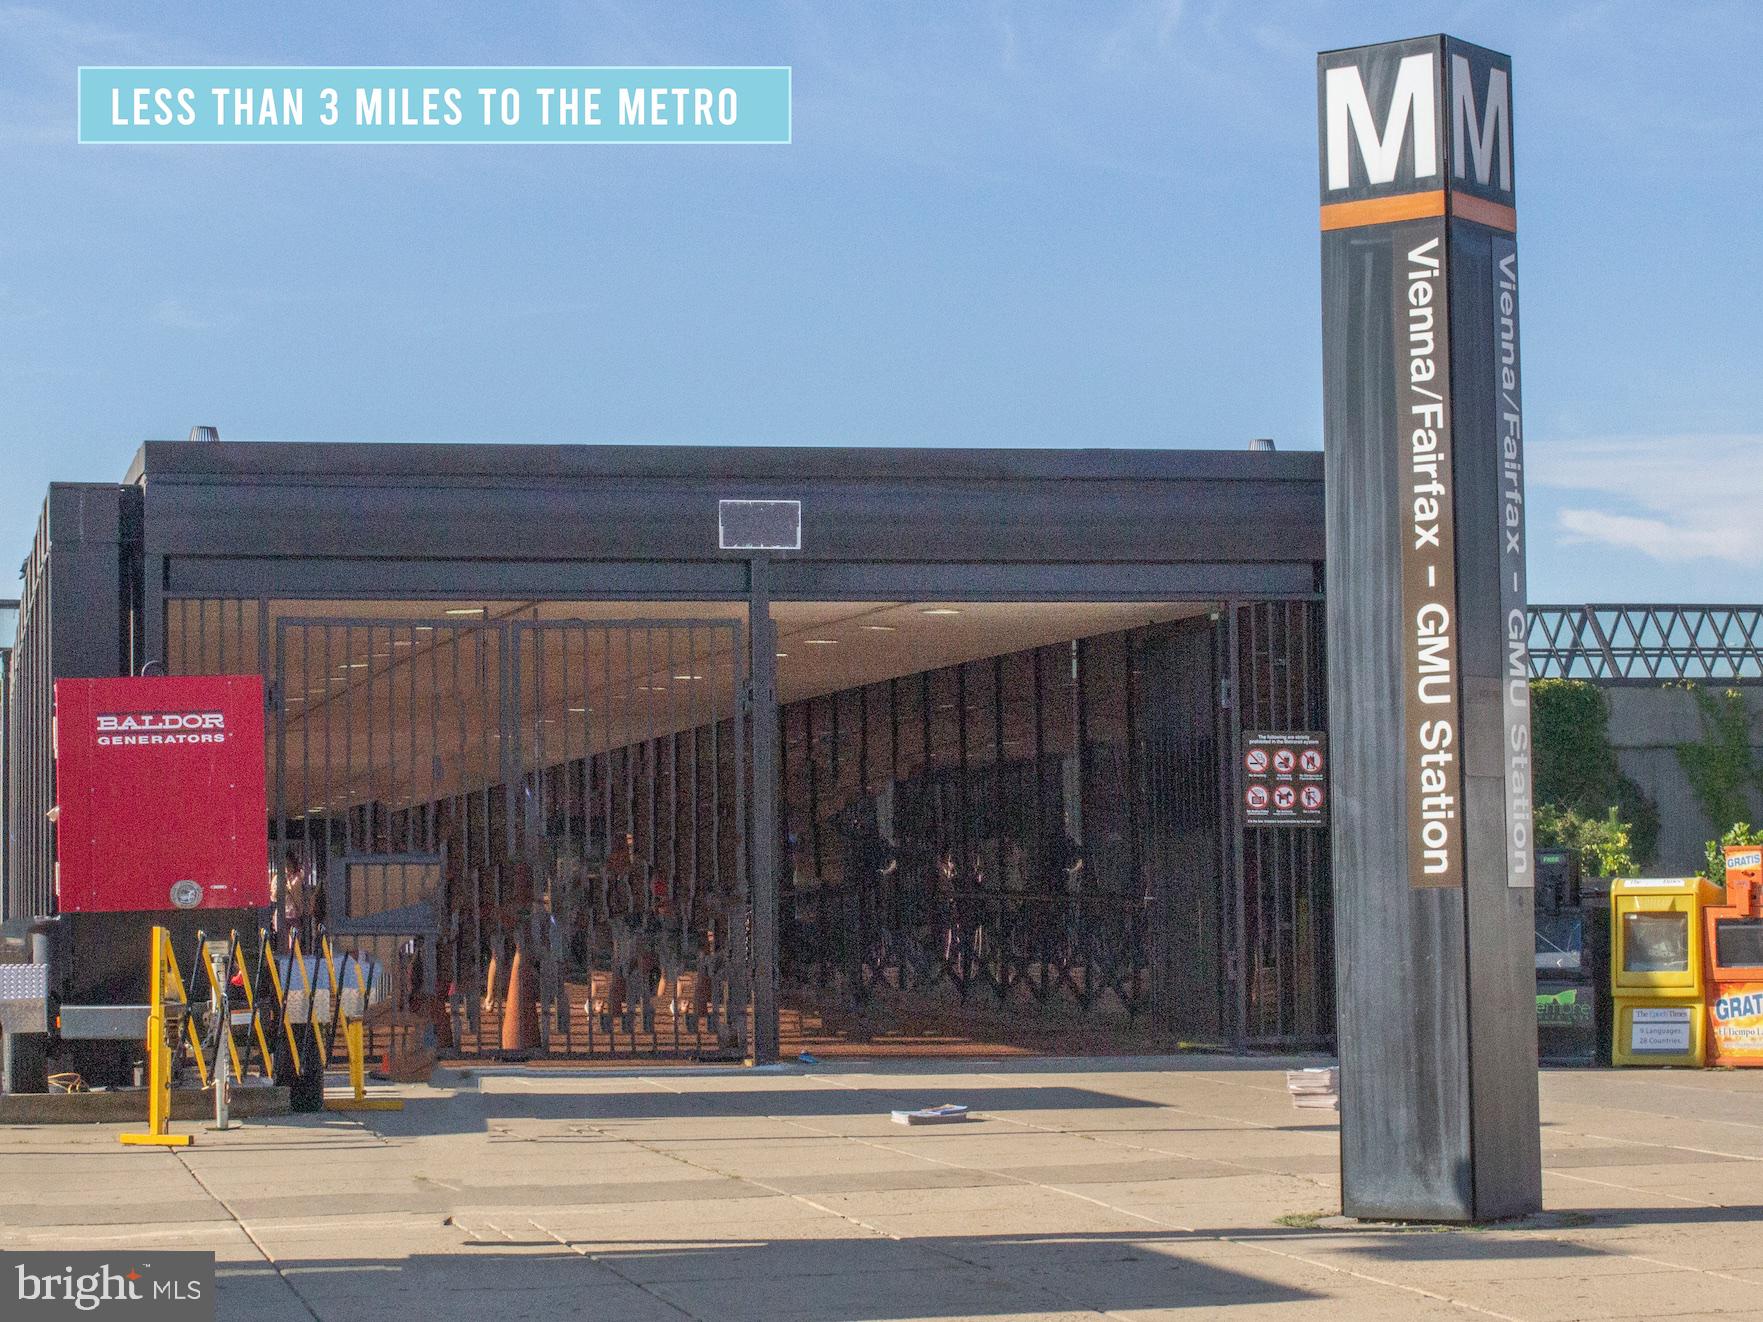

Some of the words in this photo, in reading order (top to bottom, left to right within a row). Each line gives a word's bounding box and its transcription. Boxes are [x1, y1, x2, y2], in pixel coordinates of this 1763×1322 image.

[1326, 53, 1436, 190] M
[1452, 53, 1511, 192] M
[1408, 237, 1445, 549] Vienna/Fairfax
[1499, 253, 1523, 554] Vienna/Fairfax
[1417, 603, 1451, 704] GMU
[1508, 608, 1527, 708] GMU
[97, 713, 225, 731] BALDOR
[98, 733, 225, 746] GENERATORS
[1420, 720, 1454, 874] Station
[1511, 724, 1530, 874] Station
[1727, 854, 1760, 868] GRATIS
[1637, 1010, 1648, 1018] The
[1669, 1010, 1688, 1018] Times
[1646, 1028, 1681, 1036] Languages
[1716, 993, 1763, 1020] GRAT
